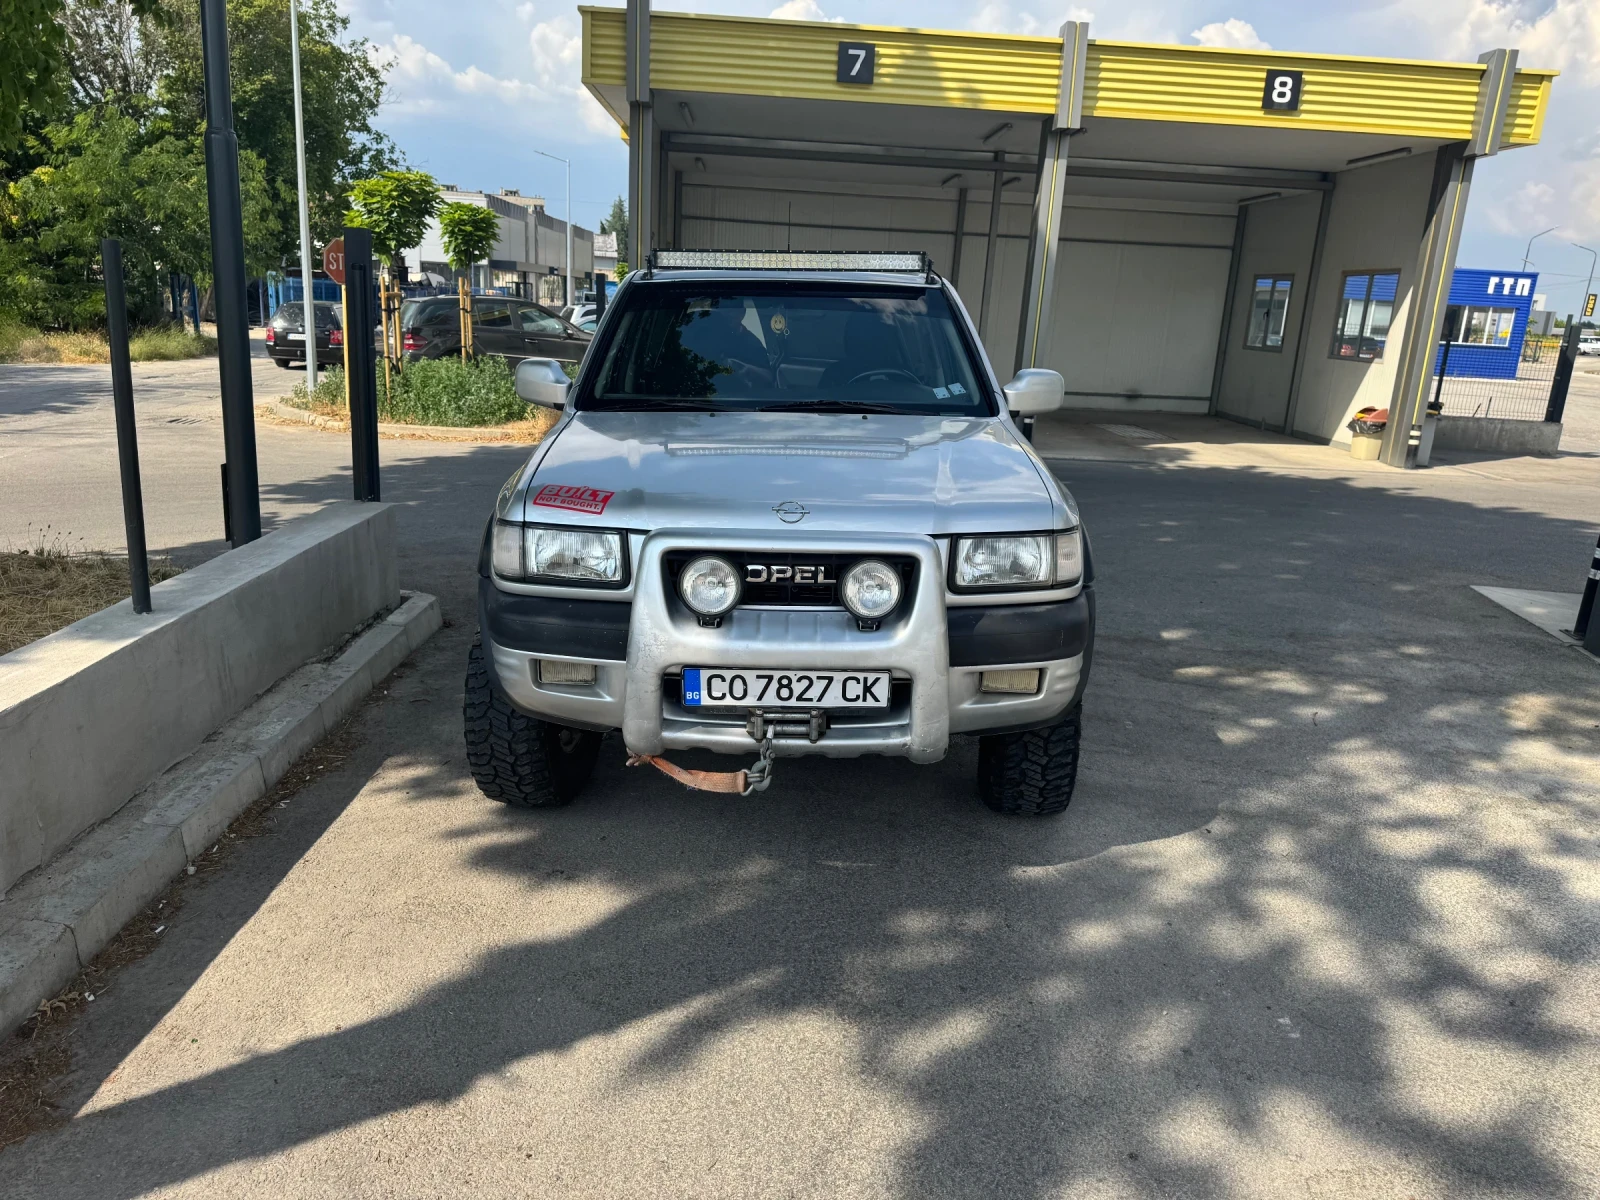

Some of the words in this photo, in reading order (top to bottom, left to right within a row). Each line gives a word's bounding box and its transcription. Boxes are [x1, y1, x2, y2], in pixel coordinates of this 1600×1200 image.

[848, 49, 866, 76] 7
[1271, 76, 1293, 103] 8
[329, 252, 344, 271] ST
[1487, 276, 1532, 296] ГТП
[538, 496, 559, 504] NOT
[560, 499, 600, 511] BOUGHT.
[543, 487, 610, 502] BUILT
[745, 565, 837, 584] OPEL
[686, 691, 700, 700] BG
[706, 674, 748, 701] CO
[756, 675, 834, 702] 7827
[841, 676, 882, 703] CK
